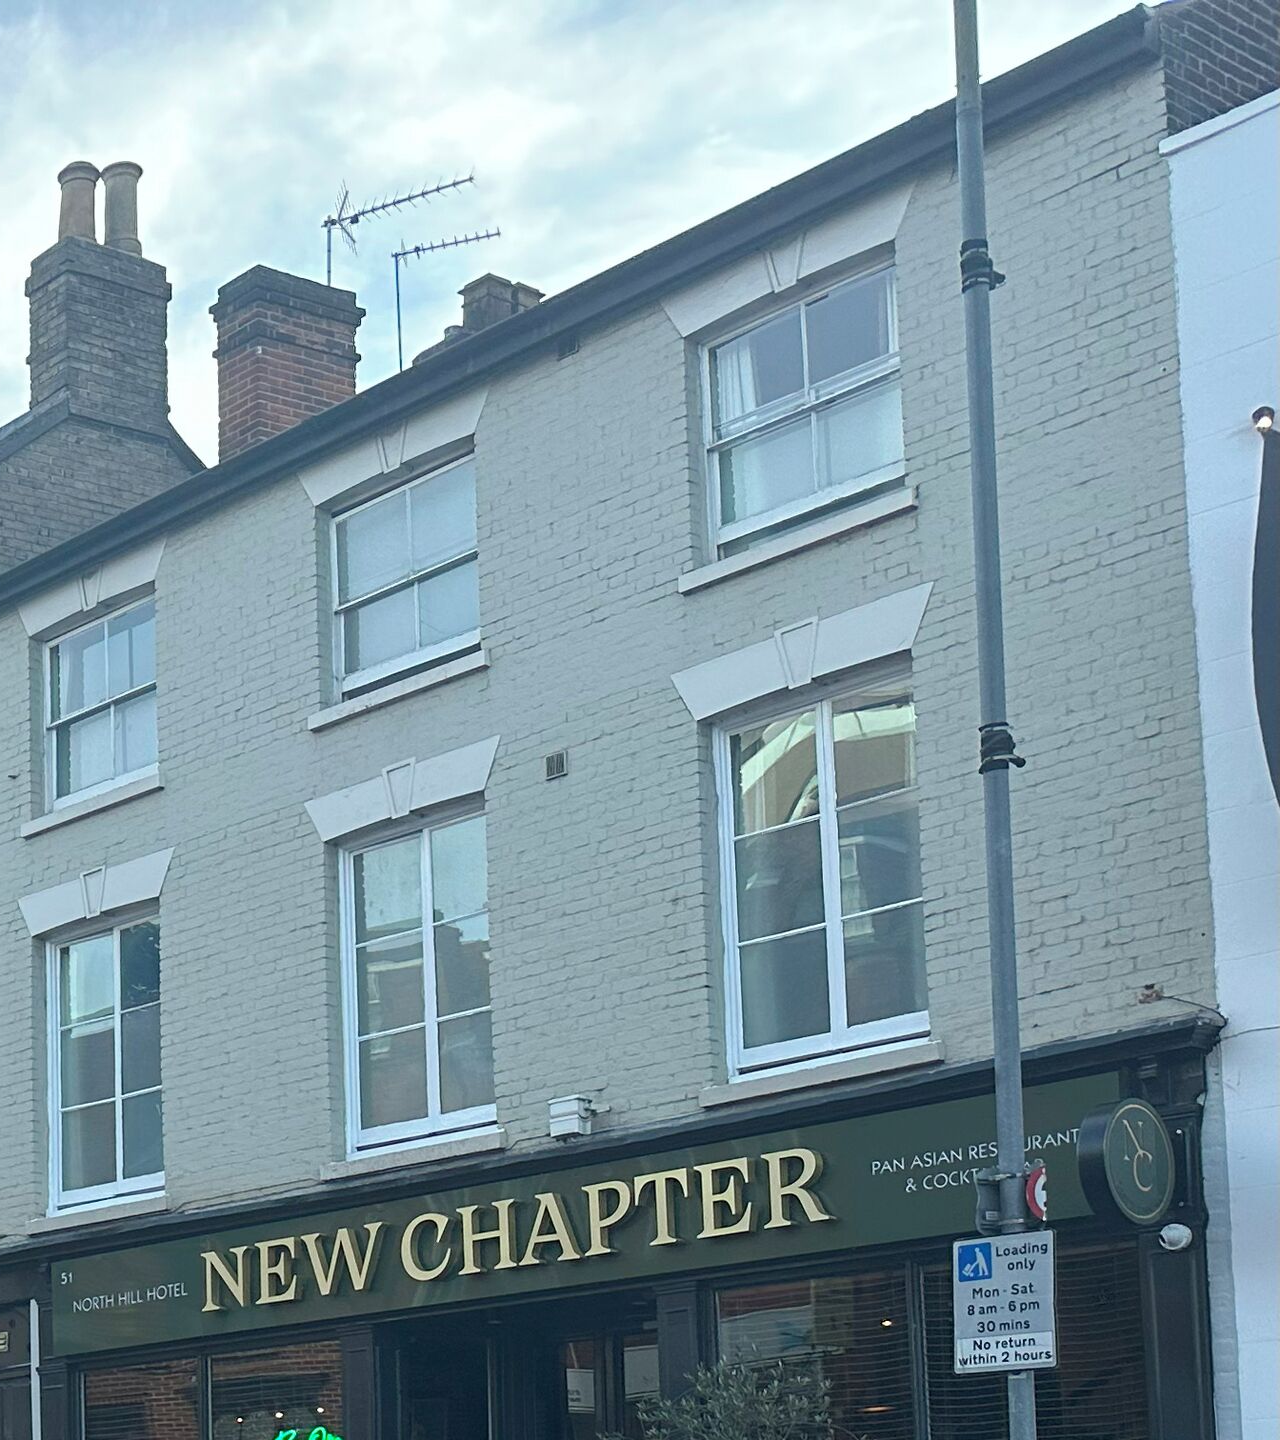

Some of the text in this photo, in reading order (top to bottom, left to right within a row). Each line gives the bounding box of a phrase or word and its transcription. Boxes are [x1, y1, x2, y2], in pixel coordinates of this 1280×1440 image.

[871, 1127, 1079, 1176] PAN ASIAN RESURANT
[905, 1177, 917, 1193] &
[200, 1147, 839, 1312] NEW CHAPTER
[995, 1243, 1048, 1257] Loading
[1007, 1259, 1036, 1271] only
[60, 1272, 73, 1285] 51
[72, 1282, 188, 1313] NORTH HILL HOTEL
[972, 1288, 1000, 1299] Mon
[1010, 1282, 1034, 1295] Sat
[967, 1305, 975, 1316] 8
[978, 1305, 997, 1315] am
[1008, 1300, 1017, 1312] 6
[1020, 1300, 1040, 1313] pm
[977, 1319, 1031, 1333] 30 mins
[973, 1337, 1036, 1351] No return
[958, 1350, 1052, 1366] within 2 hours
